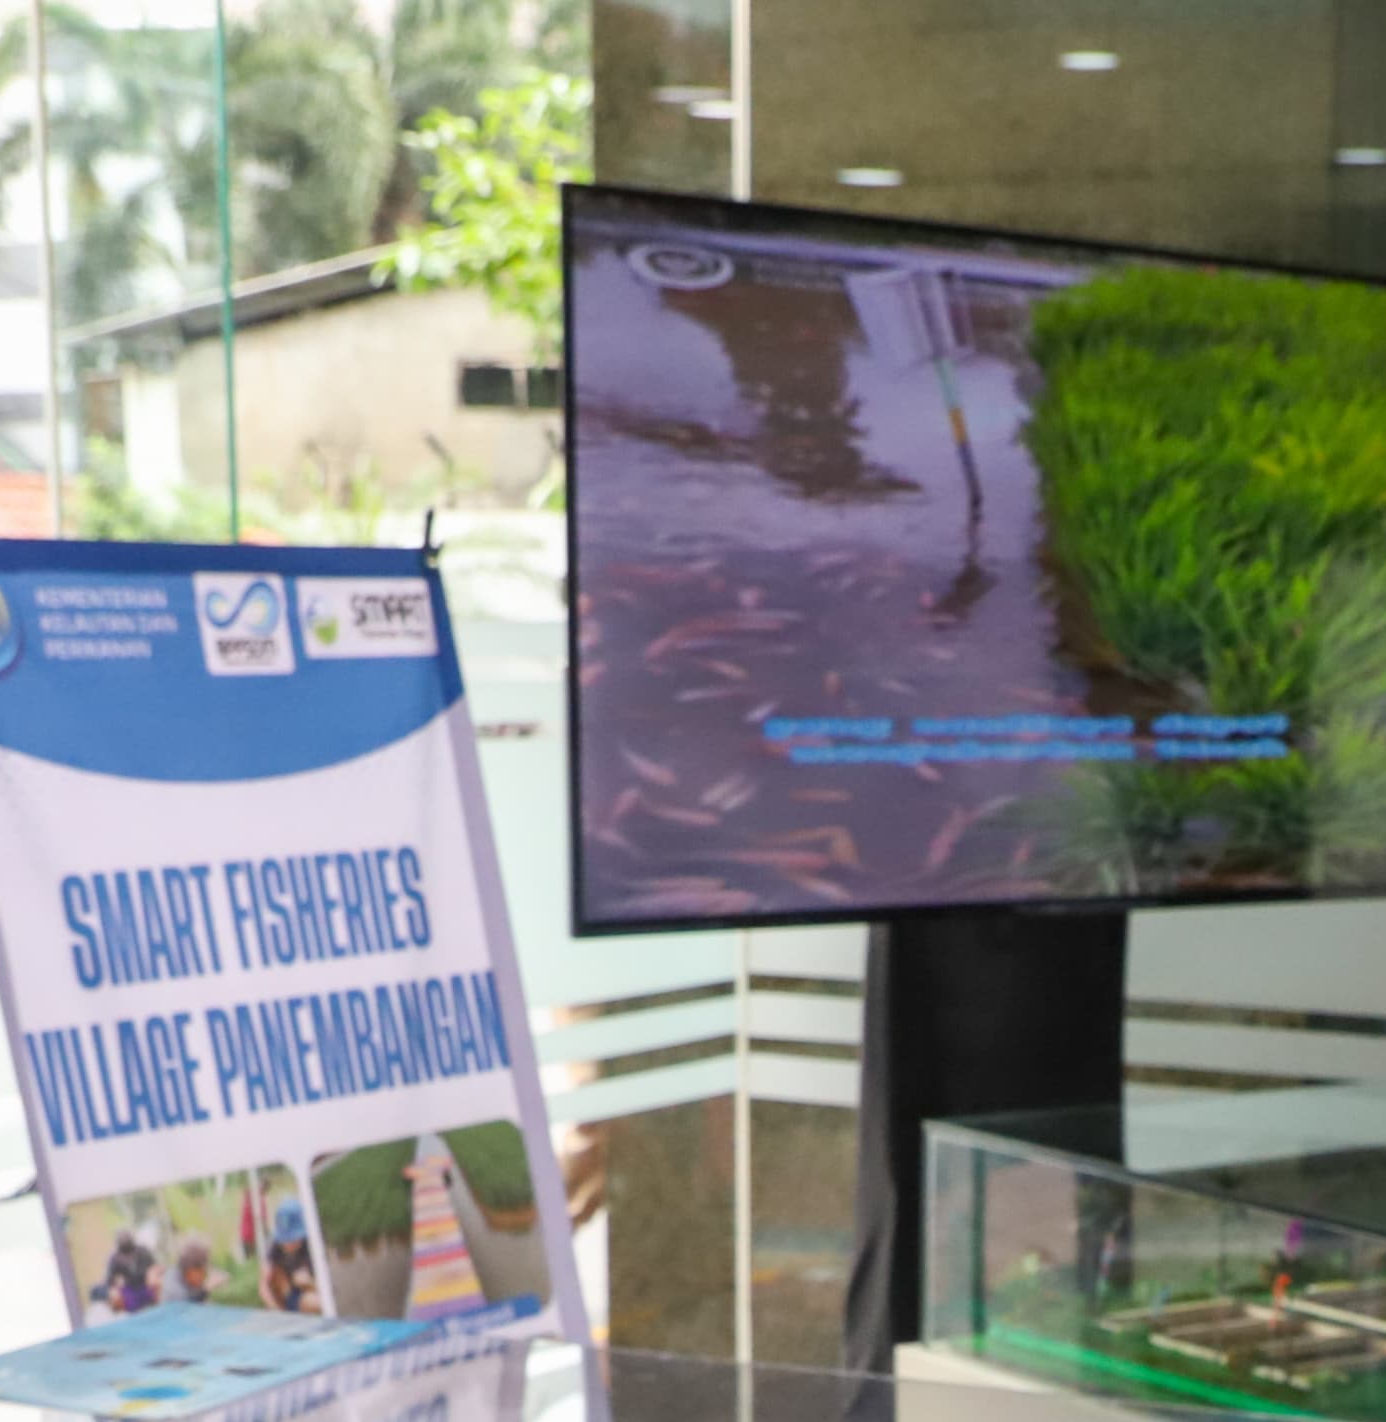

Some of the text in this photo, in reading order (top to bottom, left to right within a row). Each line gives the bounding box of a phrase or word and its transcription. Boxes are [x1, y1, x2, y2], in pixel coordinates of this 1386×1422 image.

[60, 846, 431, 989] SMART FISHERIES
[25, 969, 513, 1148] VILLAGE PANEMBANGAN
